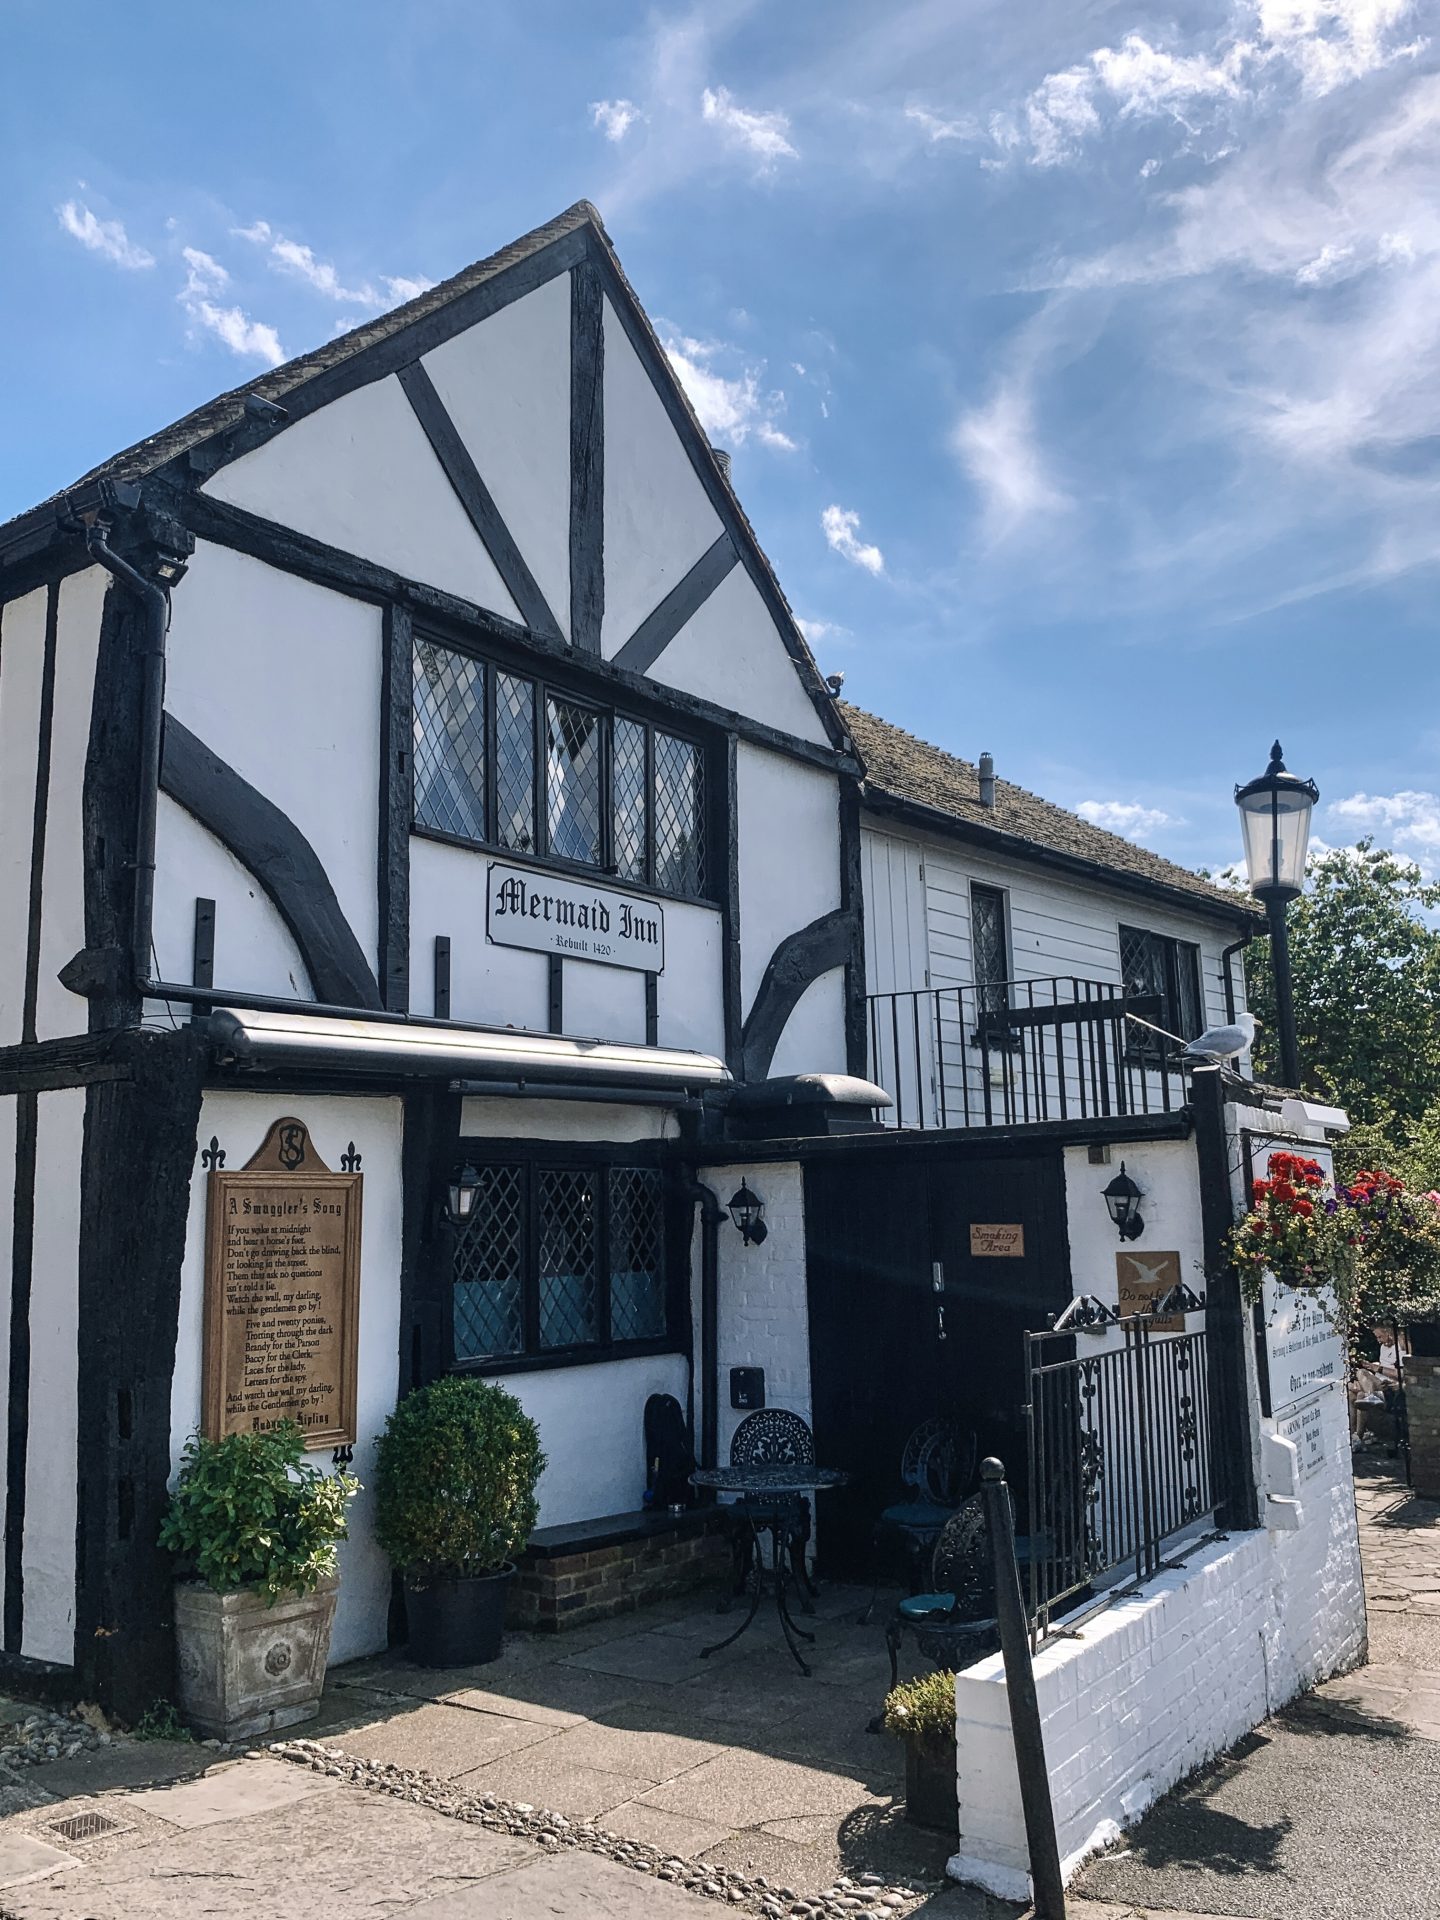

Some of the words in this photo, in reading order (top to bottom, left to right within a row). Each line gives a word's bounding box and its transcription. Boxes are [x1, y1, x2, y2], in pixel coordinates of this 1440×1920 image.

[495, 877, 610, 933] Mermaid
[619, 903, 658, 945] Inn
[556, 934, 588, 951] Rebuilt
[593, 942, 611, 956] 1420
[229, 1198, 238, 1214] A
[243, 1198, 308, 1217] Smuggler's
[313, 1198, 341, 1216] Song
[228, 1225, 235, 1234] If
[236, 1227, 249, 1237] you
[252, 1225, 269, 1234] wake
[279, 1224, 311, 1235] midnight
[973, 1227, 1018, 1244] Smoking
[227, 1237, 241, 1246] and
[244, 1236, 258, 1245] hear
[266, 1235, 289, 1244] horse's
[981, 1240, 1011, 1251] Area
[228, 1248, 249, 1257] Don't
[251, 1250, 259, 1259] go
[262, 1247, 289, 1258] drawing
[291, 1247, 307, 1255] back
[309, 1246, 320, 1254] the
[237, 1260, 264, 1270] looking
[266, 1260, 272, 1268] in
[275, 1259, 286, 1267] the
[227, 1271, 249, 1280] Them
[251, 1271, 264, 1279] that
[267, 1270, 278, 1278] ask
[291, 1269, 322, 1280] questions
[226, 1283, 241, 1292] isn't
[244, 1282, 258, 1290] told
[226, 1294, 249, 1303] Watch
[252, 1293, 262, 1302] the
[265, 1292, 281, 1302] wall,
[283, 1295, 294, 1303] my
[1120, 1288, 1135, 1300] Do
[1138, 1290, 1153, 1300] not
[1156, 1288, 1164, 1300] fe
[226, 1307, 245, 1315] while
[248, 1305, 259, 1314] the
[260, 1304, 296, 1316] gentlemen
[298, 1304, 307, 1313] go
[246, 1319, 260, 1329] Five
[262, 1318, 275, 1327] and
[278, 1318, 301, 1327] twenty
[246, 1330, 275, 1341] Trotting
[277, 1327, 304, 1338] through
[306, 1326, 316, 1336] the
[318, 1325, 333, 1334] dark
[245, 1342, 271, 1352] Brandy
[272, 1340, 282, 1349] for
[285, 1340, 295, 1348] the
[297, 1339, 320, 1347] Parson
[245, 1354, 265, 1365] Baccy
[267, 1352, 277, 1361] for
[279, 1352, 291, 1360] the
[245, 1366, 264, 1375] Laces
[266, 1363, 276, 1373] for
[278, 1363, 289, 1372] the
[245, 1377, 268, 1386] Letters
[270, 1375, 281, 1384] for
[282, 1374, 294, 1383] the
[226, 1391, 242, 1402] And
[245, 1389, 265, 1399] watch
[267, 1388, 279, 1398] the
[280, 1386, 294, 1396] wall
[296, 1387, 307, 1396] my
[226, 1403, 246, 1414] while
[248, 1401, 260, 1411] the
[261, 1398, 300, 1410] Gentlemen
[301, 1398, 309, 1407] go
[296, 1411, 329, 1426] Kipling
